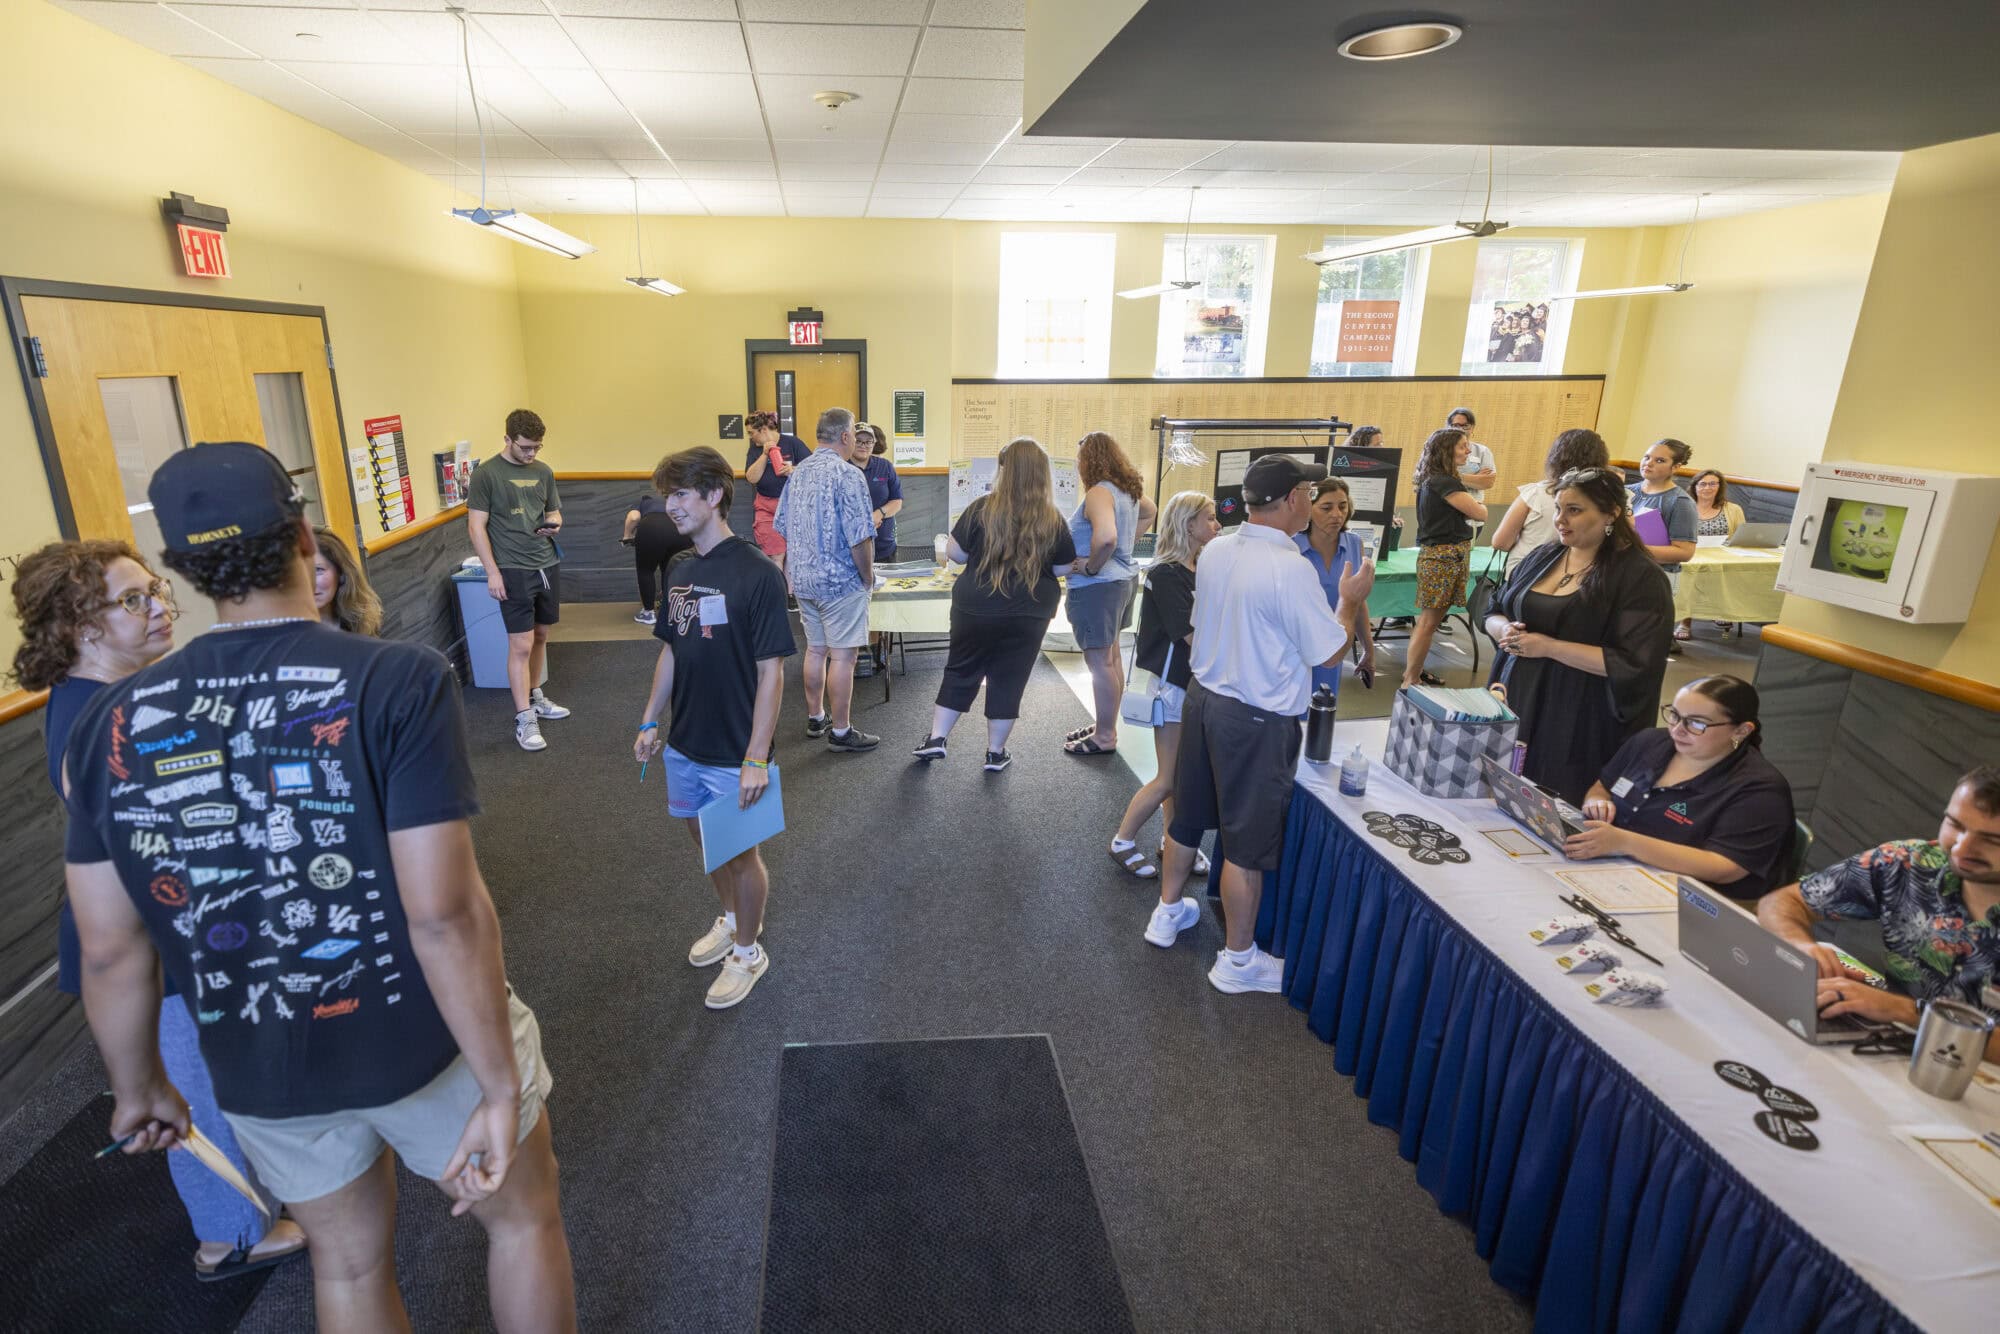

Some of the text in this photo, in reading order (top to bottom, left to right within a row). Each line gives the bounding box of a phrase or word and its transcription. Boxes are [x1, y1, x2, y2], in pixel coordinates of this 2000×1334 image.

[187, 229, 226, 276] EXIT
[795, 323, 820, 343] EXIT
[1840, 470, 1926, 486] EMERGENCY DEFIBRILLATOR
[186, 524, 242, 545] HORNETS
[261, 746, 332, 759] YOUNGLA
